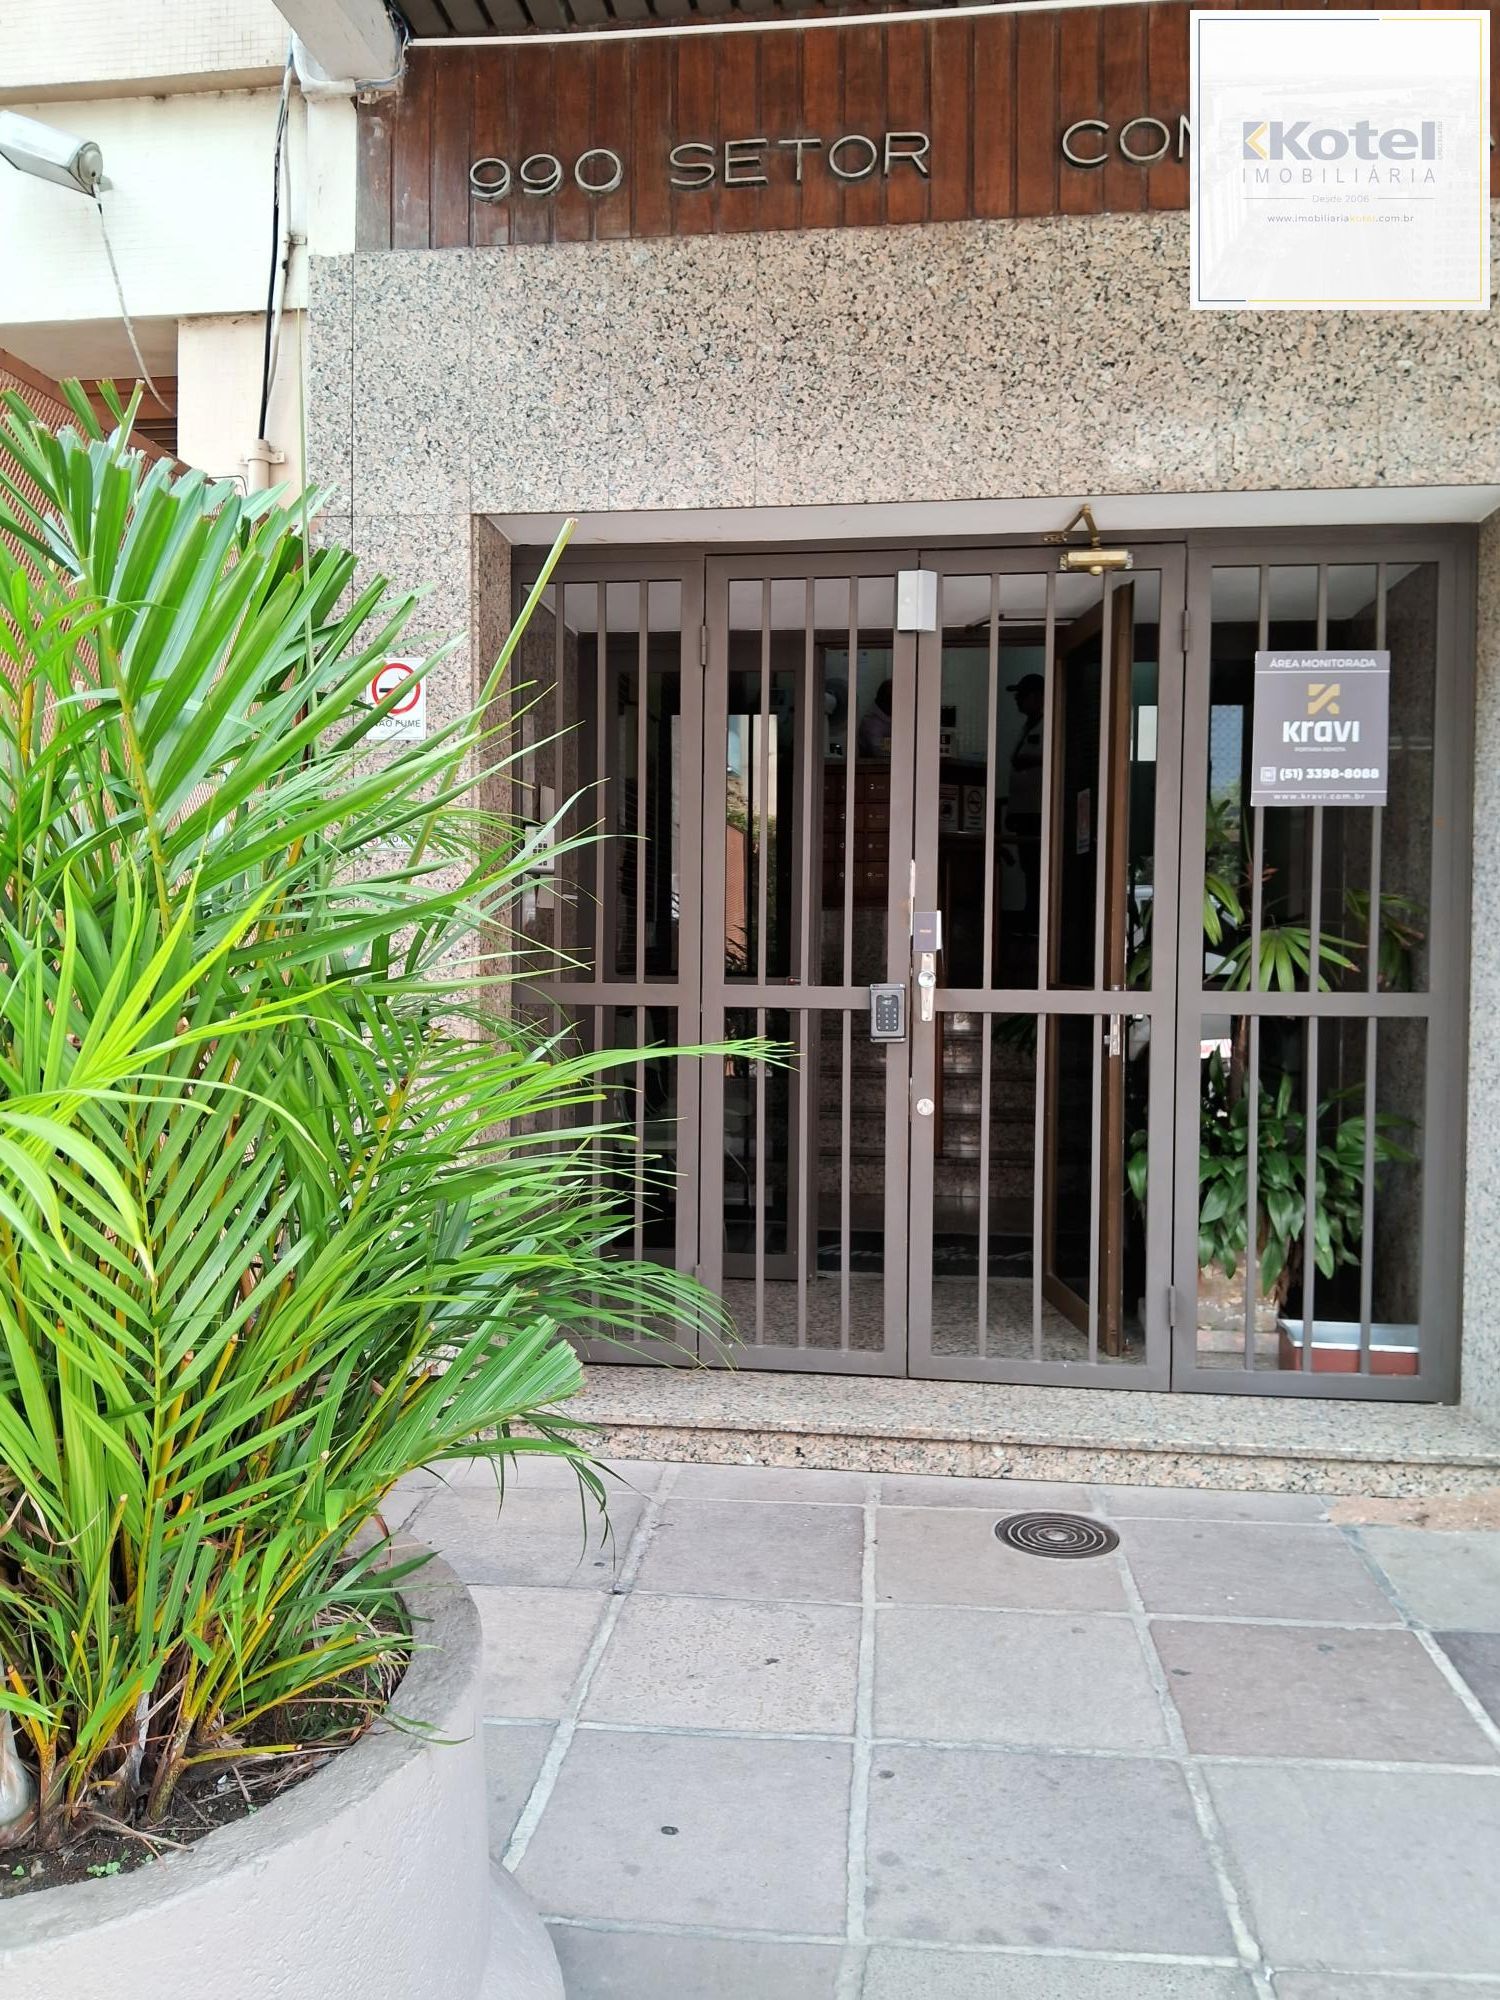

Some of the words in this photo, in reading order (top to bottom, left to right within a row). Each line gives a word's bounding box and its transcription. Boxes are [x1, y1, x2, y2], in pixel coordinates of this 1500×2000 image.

[469, 148, 624, 200] 990
[669, 130, 931, 186] SETOR
[1269, 657, 1300, 668] ÁREA
[1301, 658, 1377, 668] MONITORADA
[395, 719, 421, 728] FUME
[1279, 768, 1303, 781] (51)
